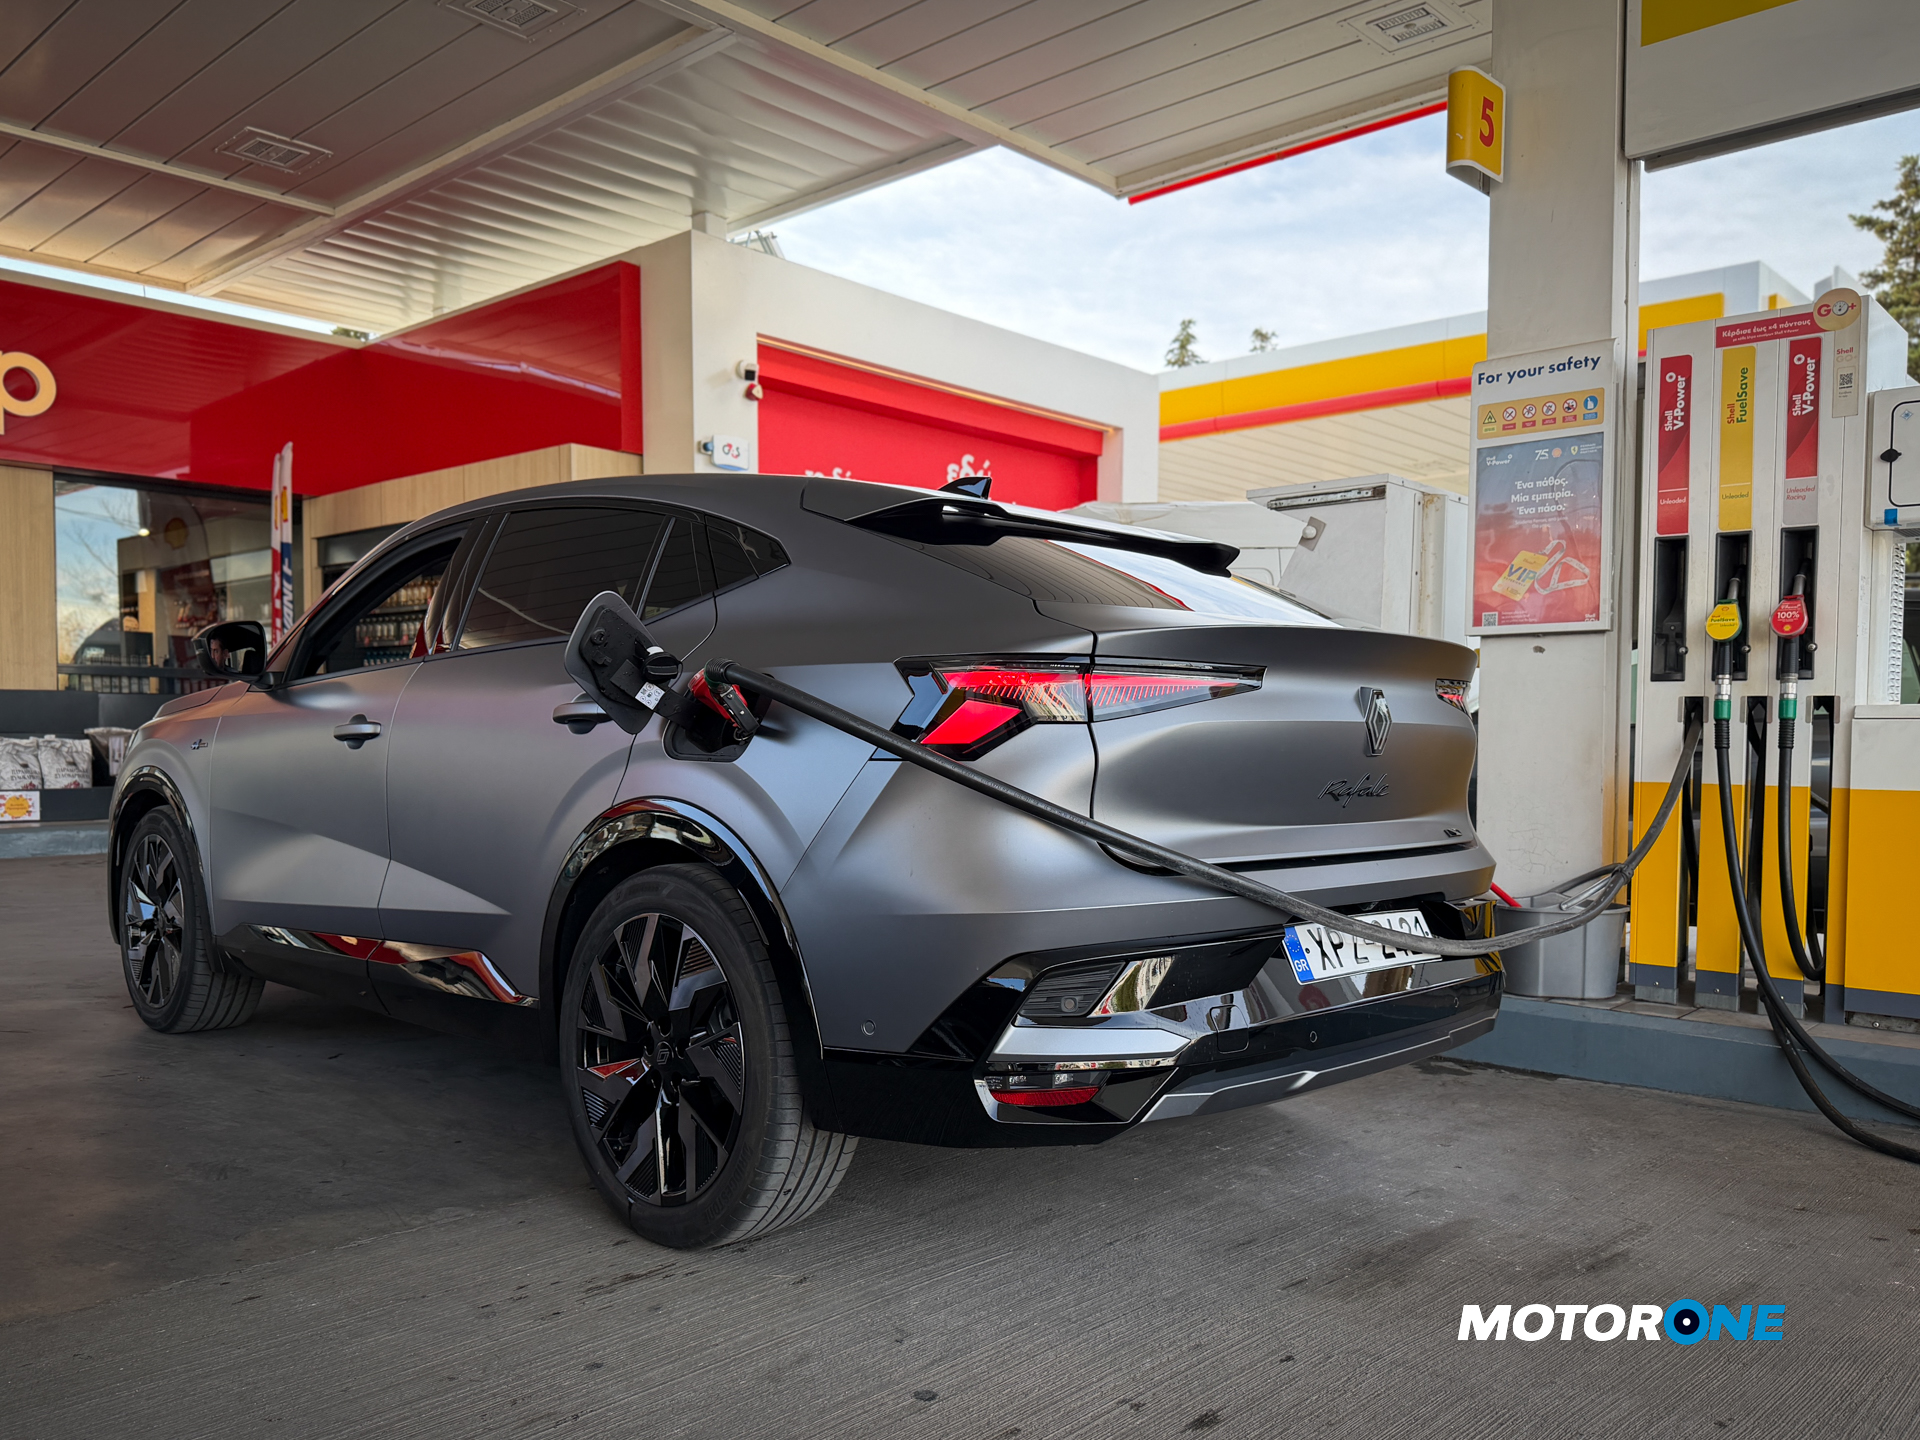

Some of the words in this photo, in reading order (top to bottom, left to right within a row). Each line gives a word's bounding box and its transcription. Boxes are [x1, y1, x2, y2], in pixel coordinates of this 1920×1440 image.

[1479, 96, 1494, 147] 5
[1722, 327, 1752, 338] Κέρδισε
[1753, 325, 1767, 334] έως
[1779, 319, 1811, 329] πόντους
[1836, 347, 1854, 355] Shell
[1477, 372, 1503, 385] For
[1507, 365, 1545, 385] your
[1548, 356, 1601, 374] safety
[1802, 357, 1816, 415] V-Power
[1673, 375, 1686, 431] V-Power
[1736, 367, 1748, 423] FuelSave
[1727, 403, 1735, 424] Shell
[1792, 394, 1801, 416] Shell
[1665, 410, 1673, 431] Shell
[1534, 448, 1549, 460] 75
[1515, 480, 1534, 490] Ένα
[1536, 476, 1569, 488] πάθος.
[1786, 485, 1816, 494] Unleaded
[1511, 494, 1530, 503] Μία
[1531, 488, 1574, 502] εμπειρία.
[1660, 497, 1687, 505] Unleaded
[1721, 491, 1749, 500] Unleaded
[1786, 493, 1806, 501] Racing
[1517, 505, 1536, 515] Ένα
[1537, 503, 1566, 513] πάσο.
[1508, 564, 1538, 583] VIP
[1777, 611, 1800, 619] 100%
[1318, 772, 1389, 808] Rafale
[1294, 959, 1309, 972] GR
